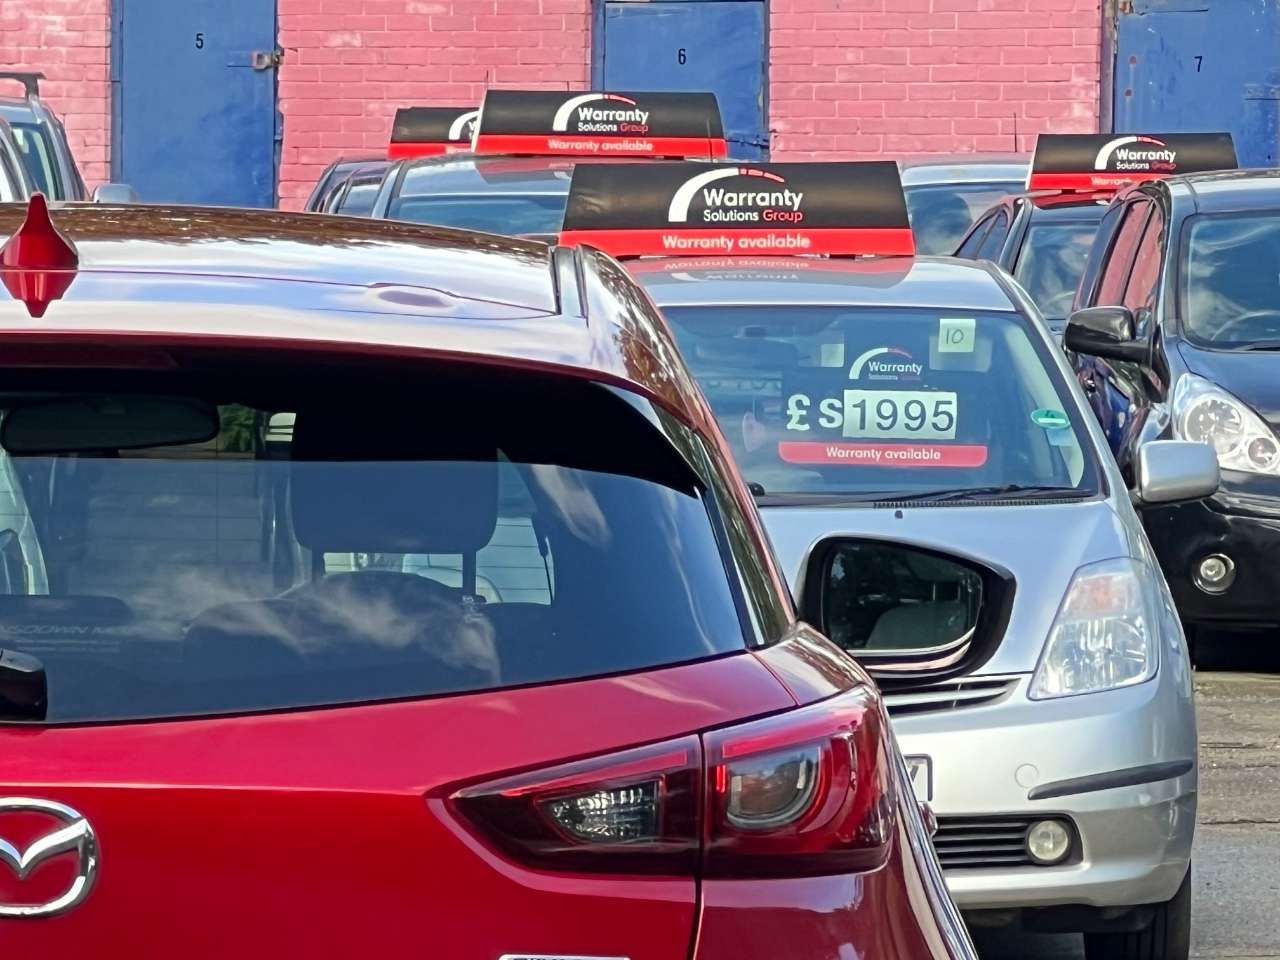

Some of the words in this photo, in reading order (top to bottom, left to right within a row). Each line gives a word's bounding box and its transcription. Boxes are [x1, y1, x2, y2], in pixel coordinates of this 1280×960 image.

[195, 33, 204, 49] 5
[678, 48, 687, 65] 6
[1194, 55, 1203, 73] 7
[578, 107, 649, 125] Warranty
[578, 122, 618, 132] Solutions
[548, 139, 600, 152] Warranty
[601, 140, 653, 151] available
[1116, 148, 1176, 163] Warranty
[703, 188, 803, 211] Warranty
[703, 209, 759, 222] Solutions
[762, 210, 803, 223] Group
[662, 235, 734, 252] Warranty
[738, 235, 811, 249] available
[868, 361, 922, 375] Warranty
[826, 447, 881, 461] Warranty
[885, 449, 941, 460] available
